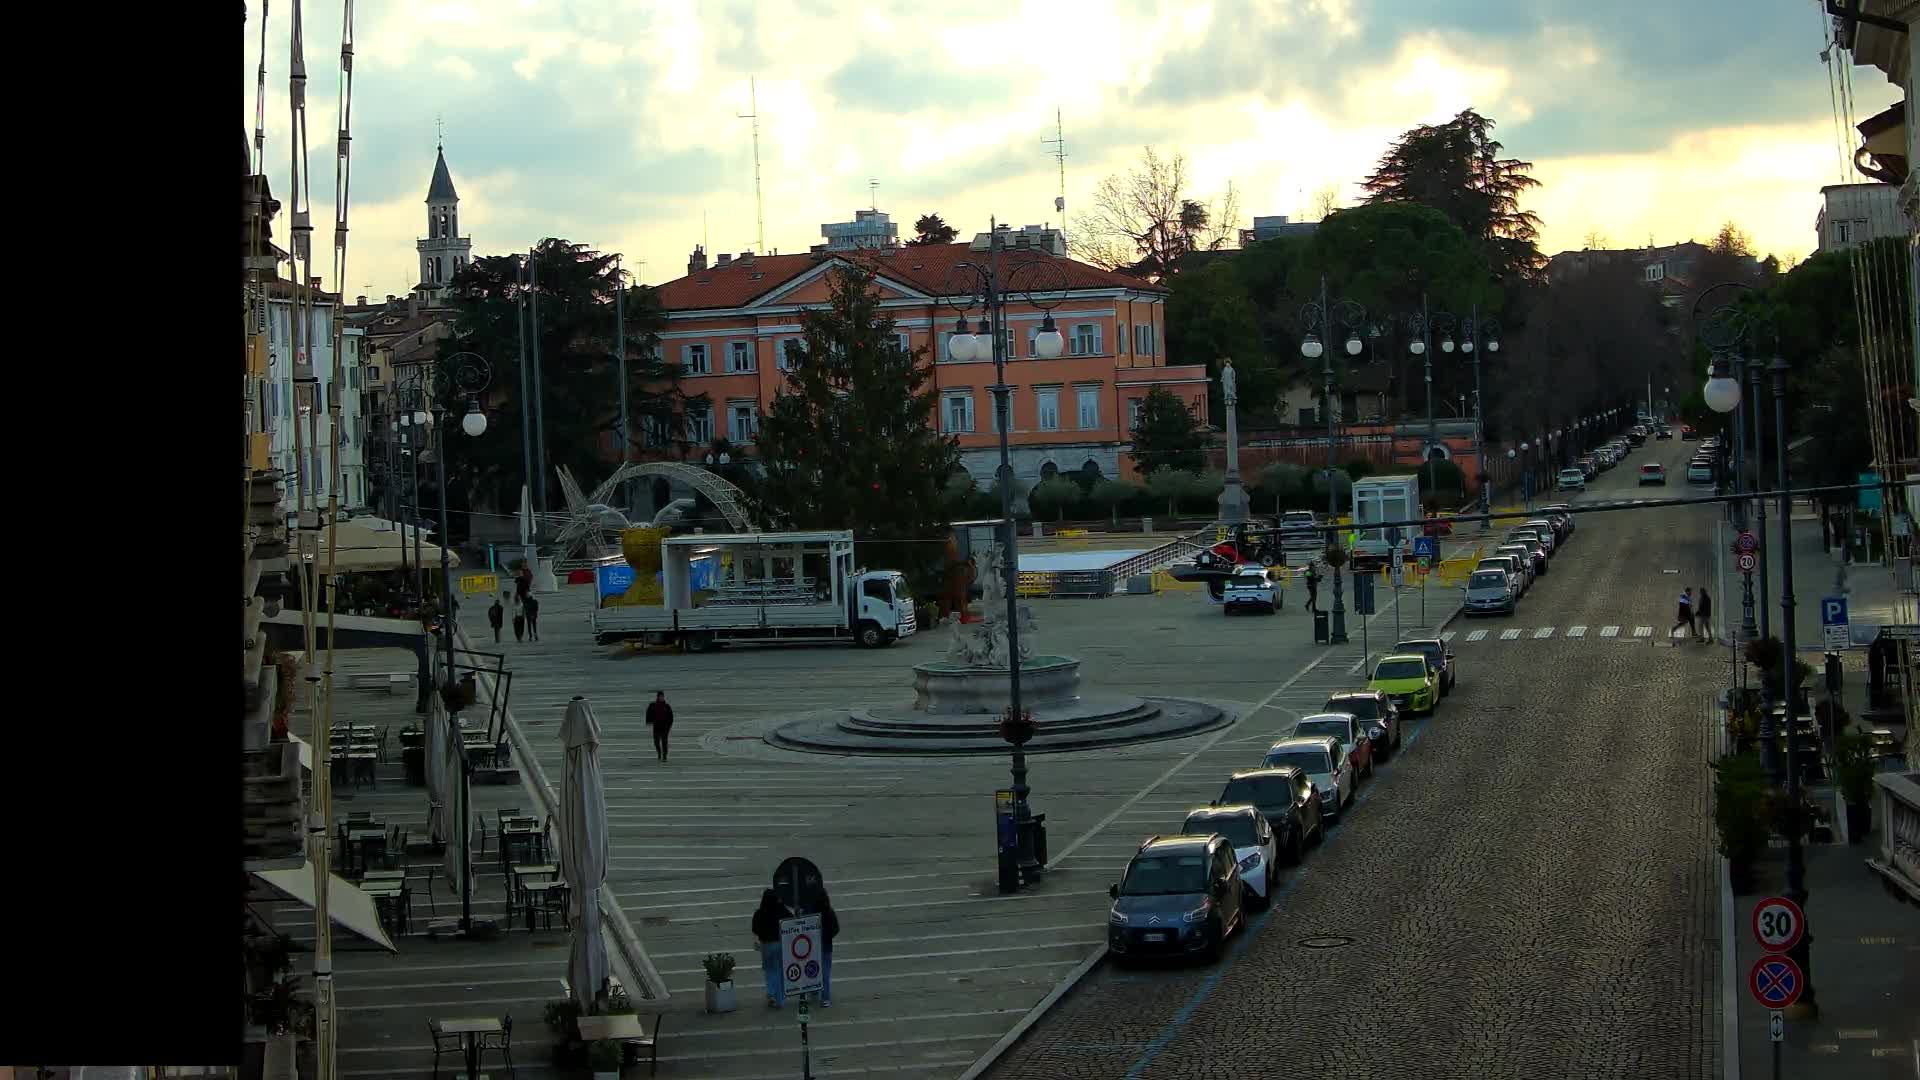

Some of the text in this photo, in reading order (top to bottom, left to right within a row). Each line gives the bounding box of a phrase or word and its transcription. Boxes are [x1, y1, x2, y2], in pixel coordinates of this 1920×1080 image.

[1742, 557, 1753, 567] 20
[1827, 602, 1842, 621] P
[1762, 911, 1792, 938] 30
